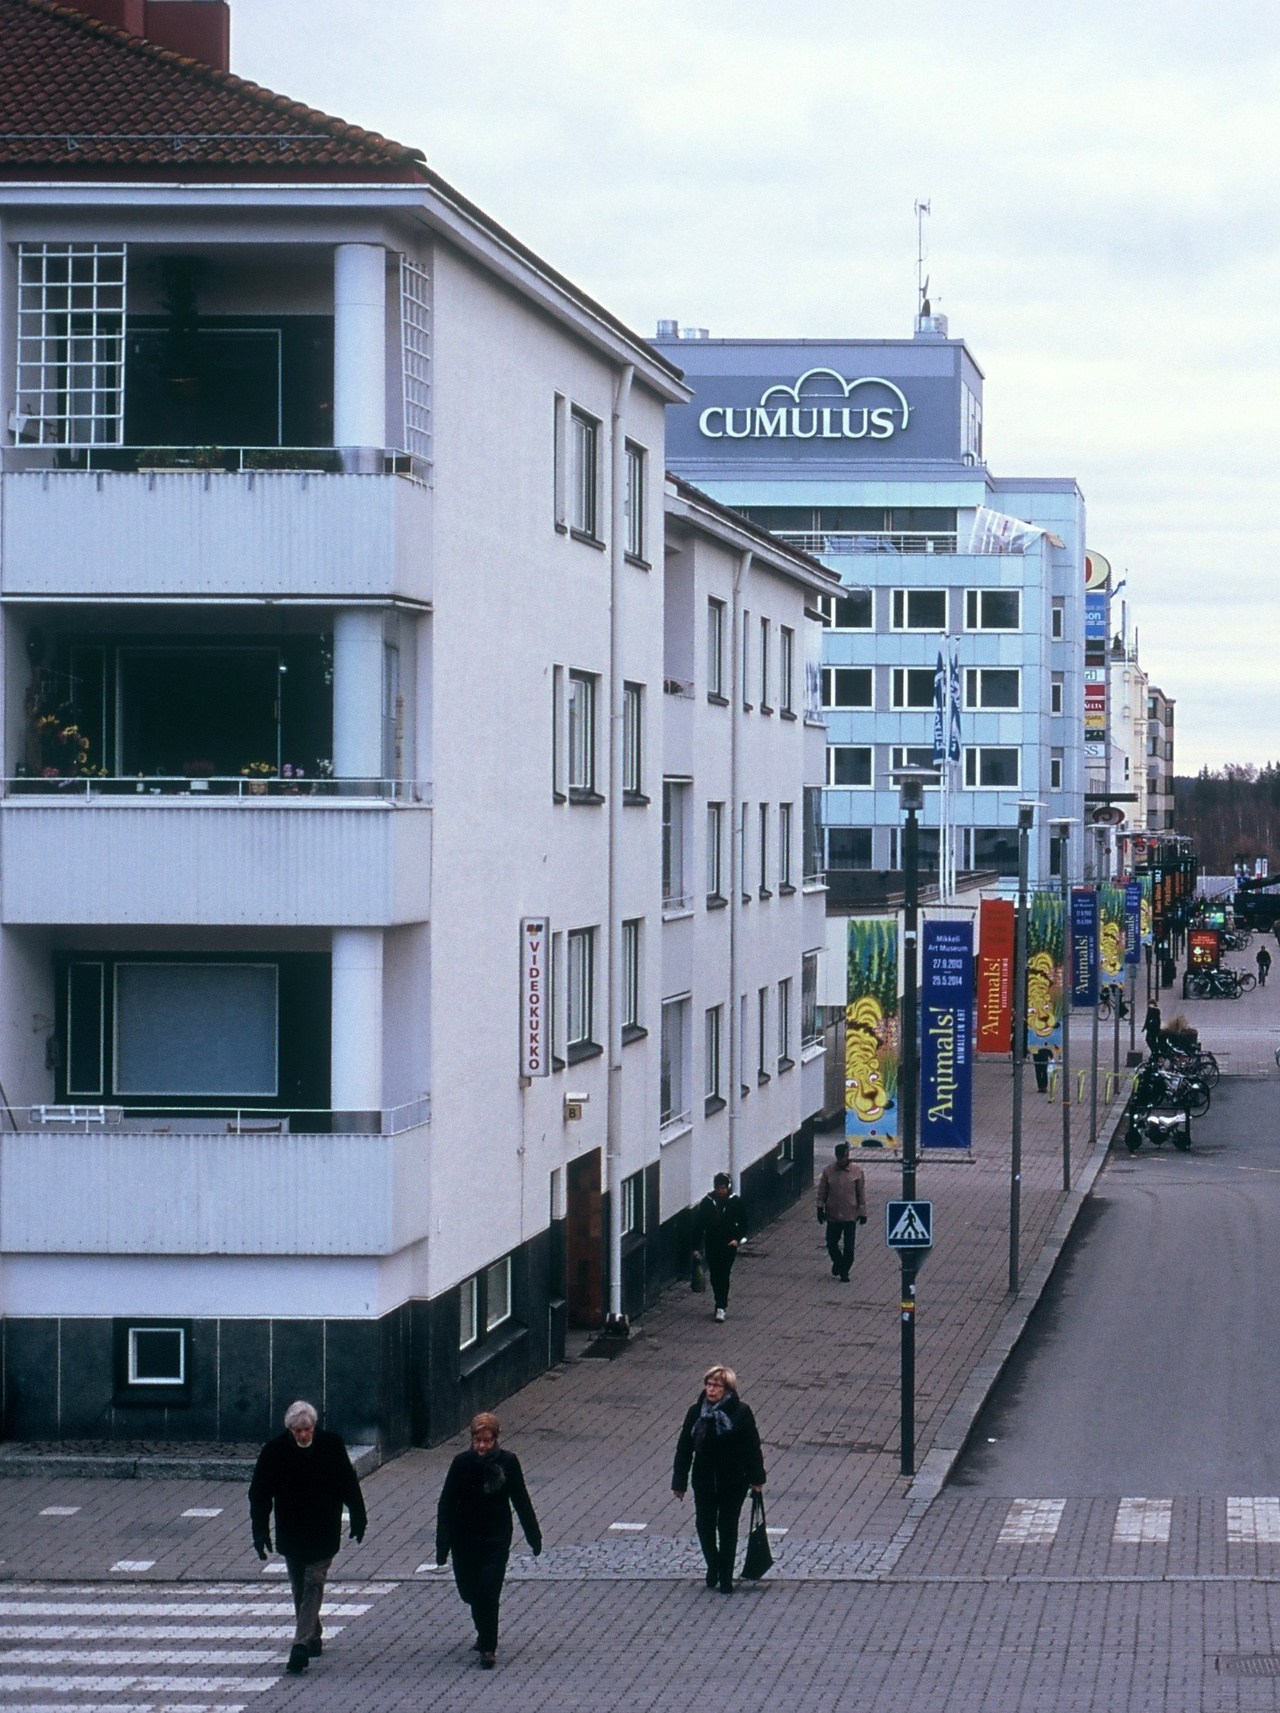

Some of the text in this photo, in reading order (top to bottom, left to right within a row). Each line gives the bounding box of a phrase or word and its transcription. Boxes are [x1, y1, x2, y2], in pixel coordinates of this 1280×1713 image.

[699, 407, 894, 438] CUMULUS
[928, 944, 968, 952] Art Museum
[936, 935, 961, 943] Mikkeli
[1075, 935, 1091, 994] Animals!
[529, 941, 540, 1070] VIDEOKUKKO
[982, 958, 1003, 1035] Animals!
[927, 1006, 959, 1122] Animals!
[569, 1108, 576, 1119] B
